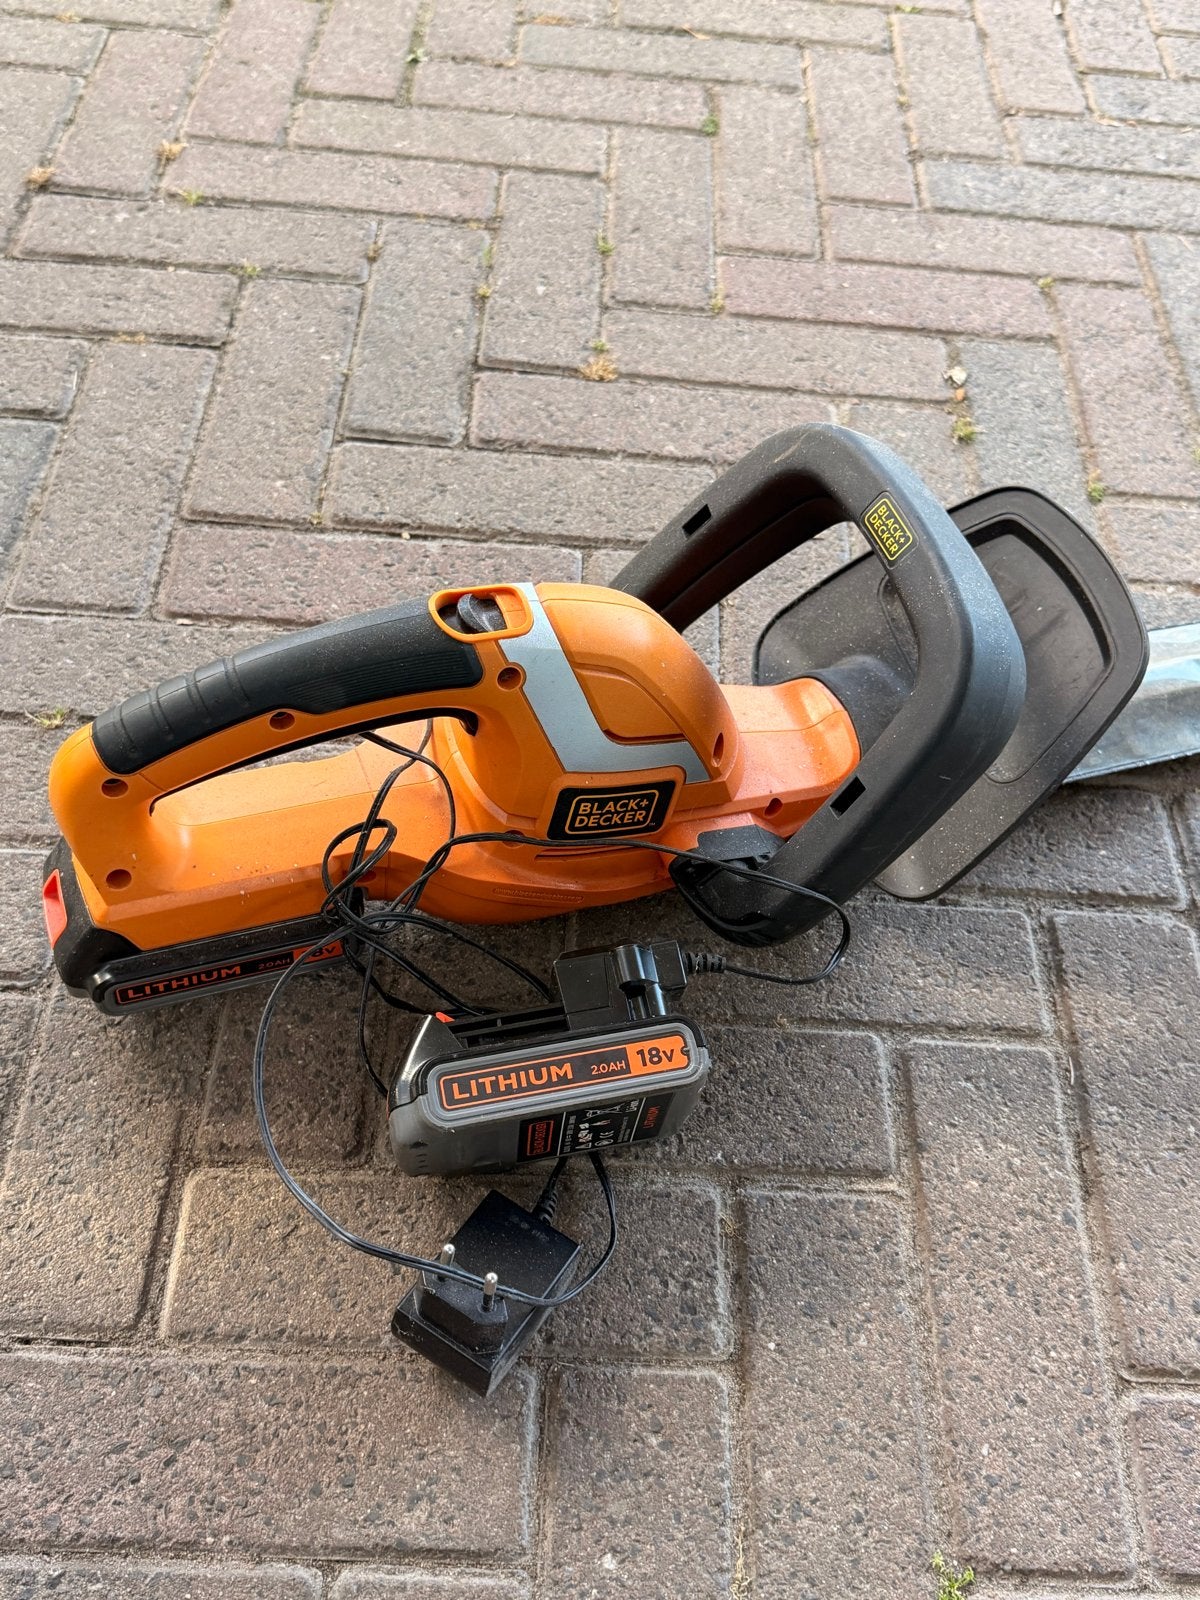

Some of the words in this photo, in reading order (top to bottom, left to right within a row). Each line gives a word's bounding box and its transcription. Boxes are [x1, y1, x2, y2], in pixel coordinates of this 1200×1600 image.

[870, 514, 899, 554] DECKER
[878, 505, 905, 543] BLACK+
[574, 810, 646, 828] DECKER
[578, 798, 649, 814] BLACK+
[127, 966, 241, 999] LITHIUM
[452, 1062, 573, 1100] LITHIUM
[591, 1059, 626, 1075] 2.0AH
